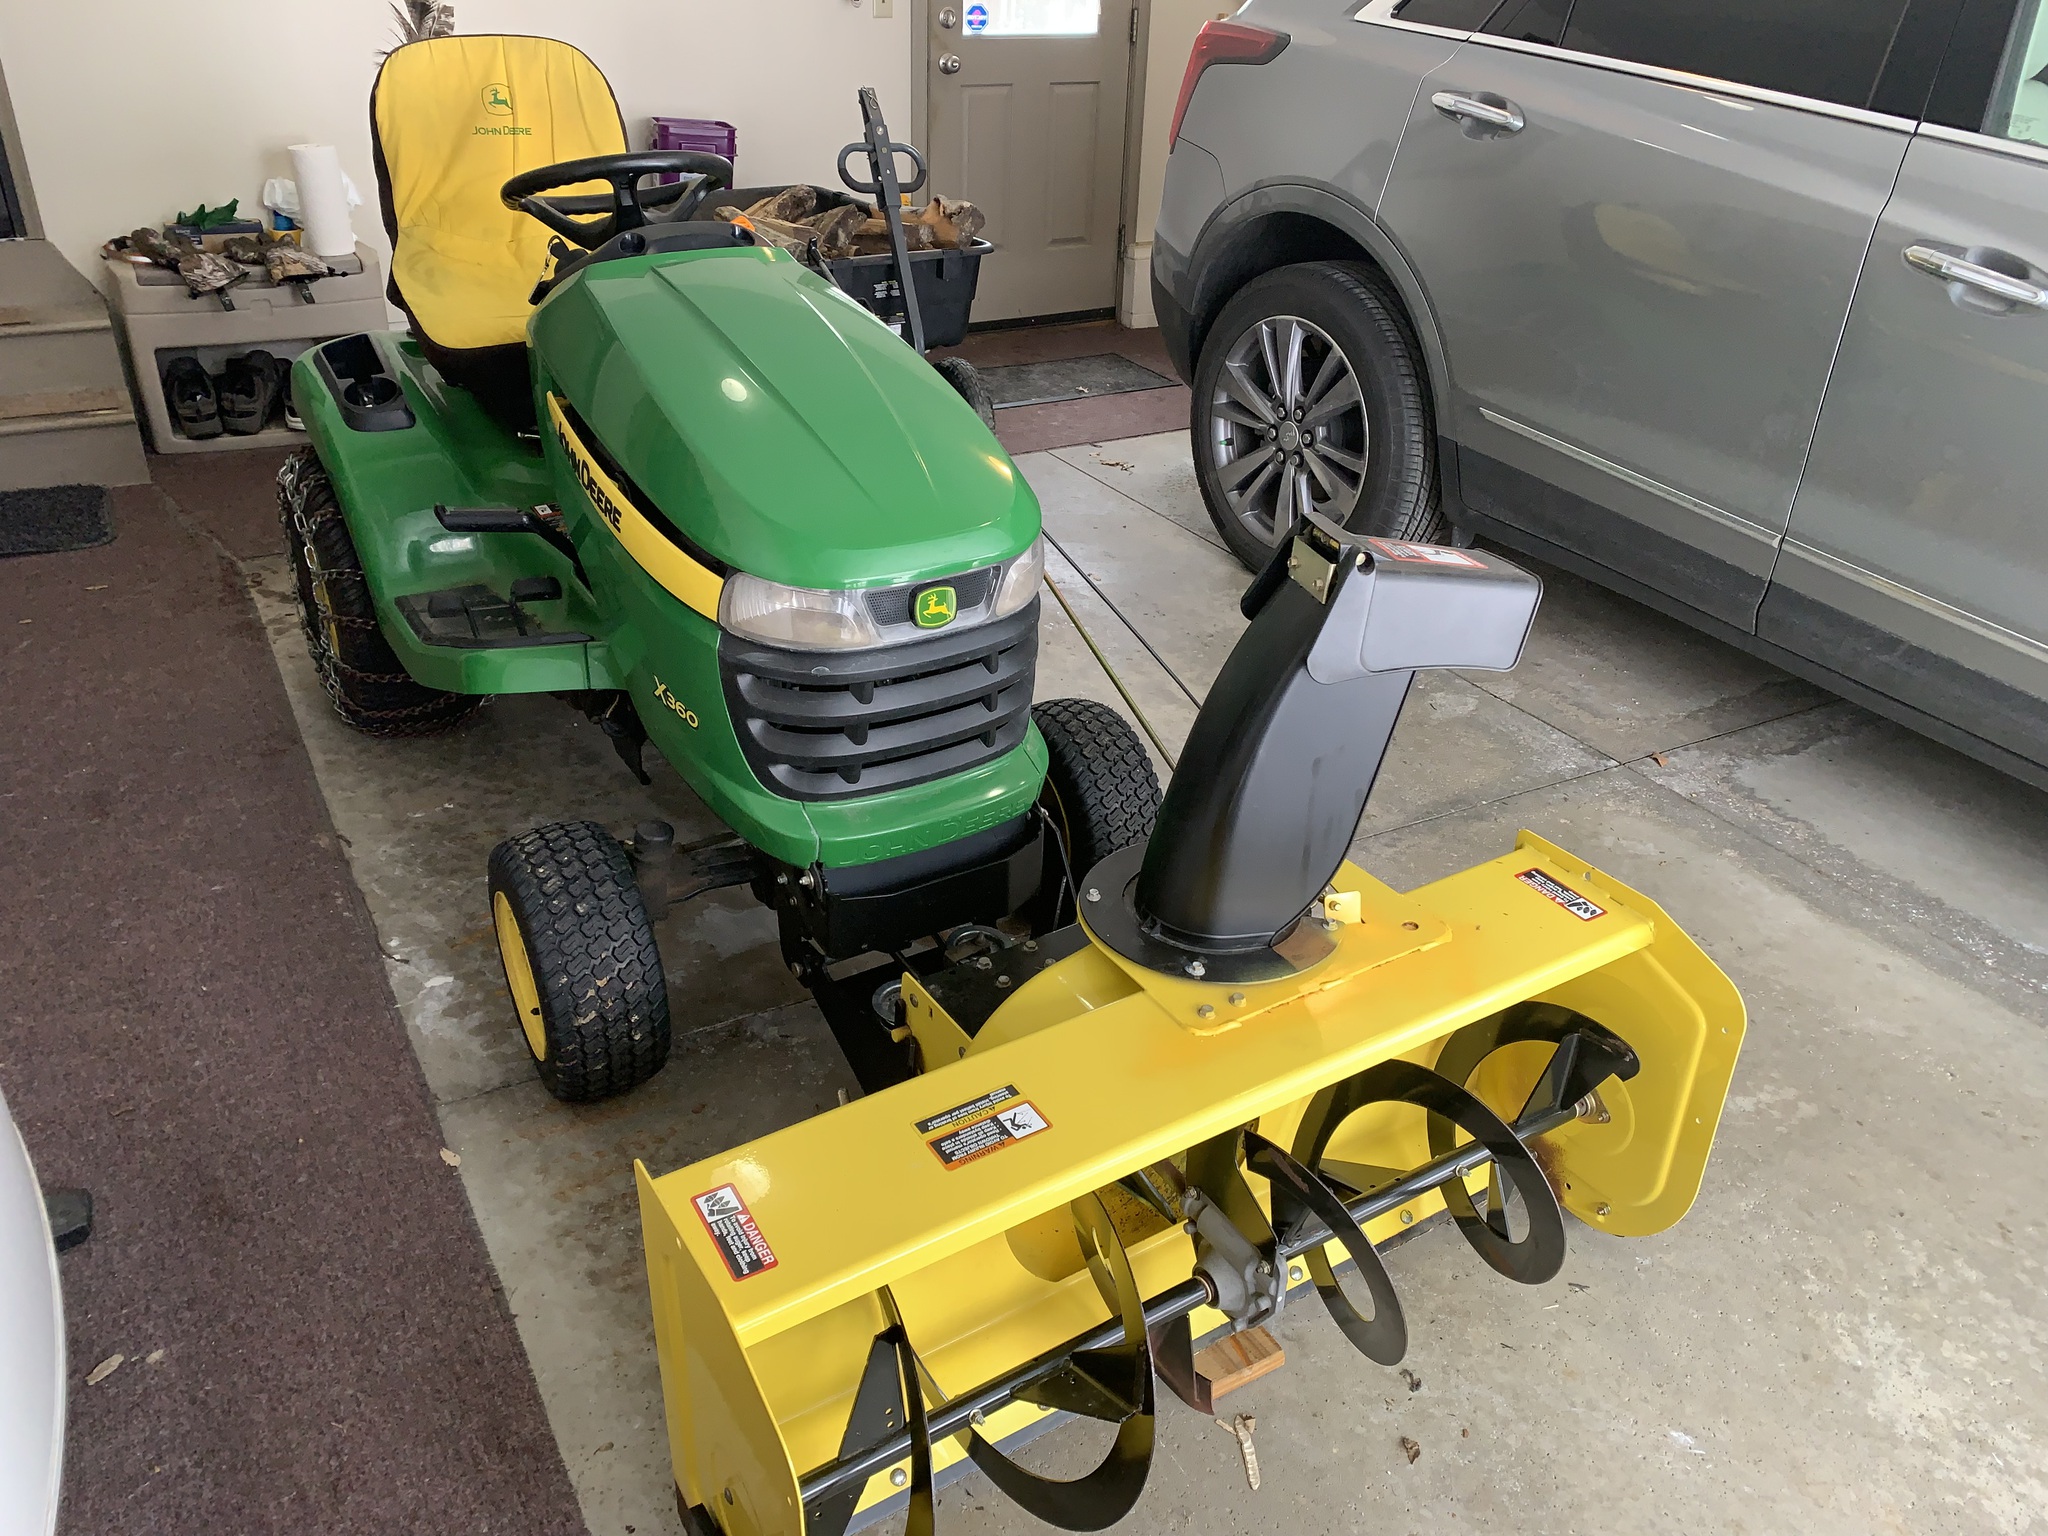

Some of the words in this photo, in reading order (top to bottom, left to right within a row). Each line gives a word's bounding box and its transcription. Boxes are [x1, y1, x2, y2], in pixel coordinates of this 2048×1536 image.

[472, 126, 502, 135] JOHN
[503, 126, 532, 135] DEERE
[581, 459, 622, 533] DEERE
[653, 674, 699, 728] X360
[1518, 876, 1555, 898] DANGER
[952, 1110, 989, 1127] CAUTION
[958, 1145, 998, 1165] WARNING
[743, 1222, 775, 1265] DANGER
